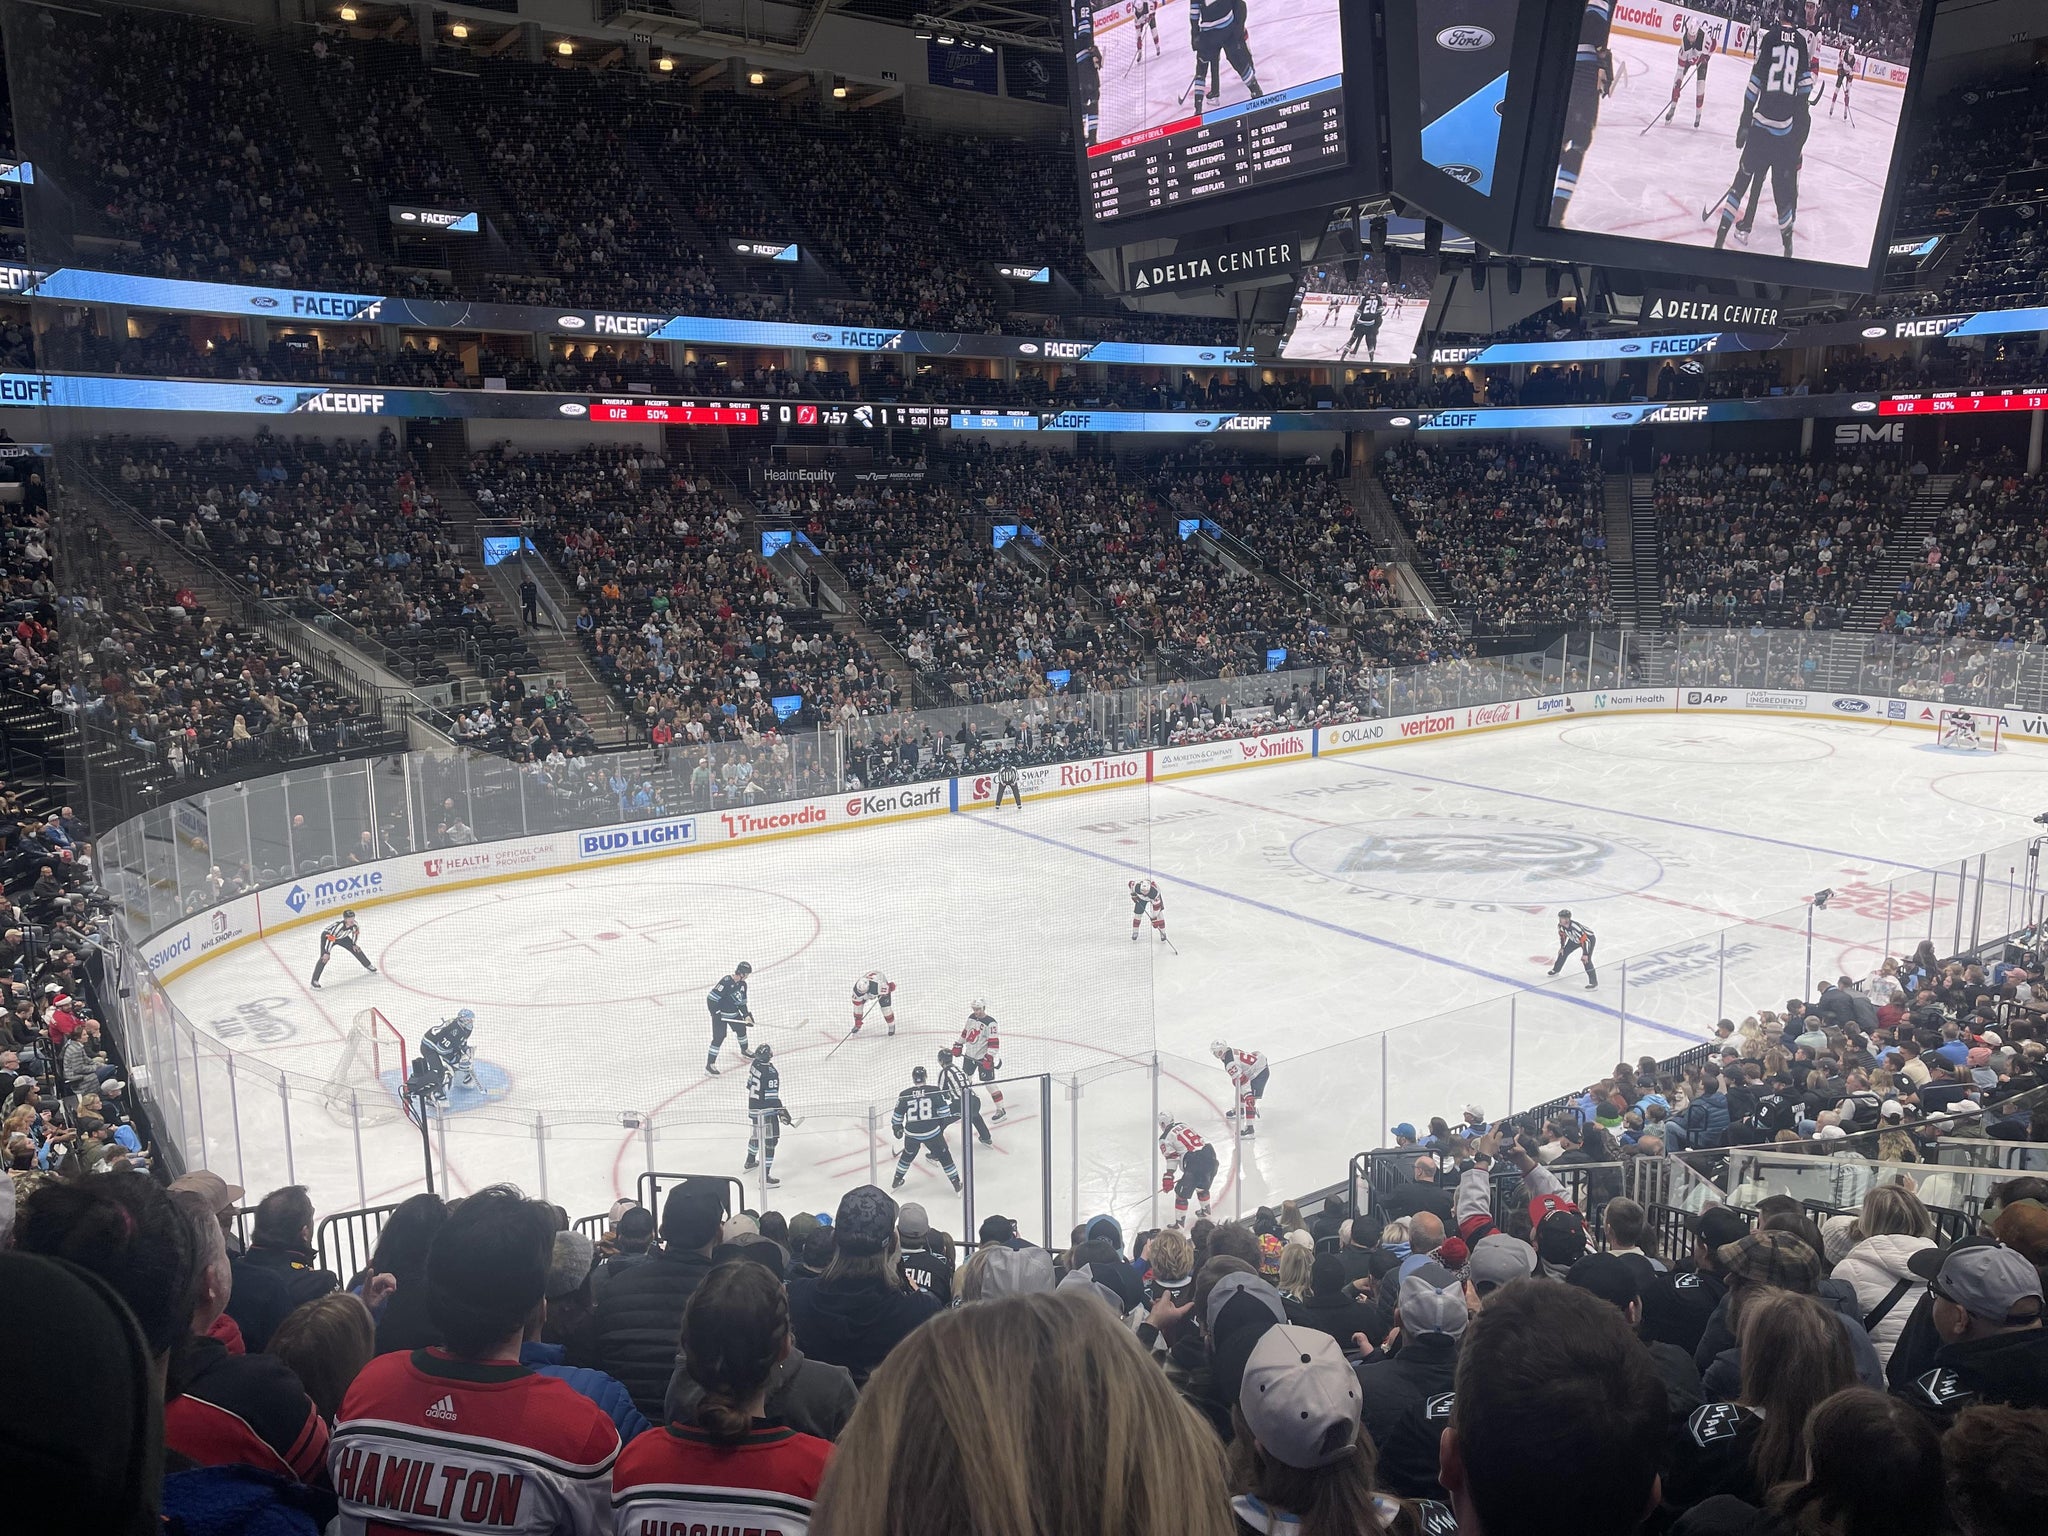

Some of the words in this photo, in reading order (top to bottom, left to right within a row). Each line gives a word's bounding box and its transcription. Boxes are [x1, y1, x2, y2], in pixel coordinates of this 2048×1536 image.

[1080, 7, 1090, 18] 82
[1781, 30, 1795, 43] COLE
[1767, 45, 1800, 95] 28
[1246, 101, 1260, 110] UTAH
[1260, 93, 1287, 106] MAMMOTH
[1279, 106, 1292, 116] TIME
[1301, 101, 1310, 110] ICE
[1261, 121, 1287, 134] STENLUND
[1323, 108, 1337, 118] 3:14
[1148, 129, 1164, 139] DEVILS
[1198, 129, 1210, 139] HITS
[1262, 136, 1275, 146] COLE
[1324, 120, 1337, 130] 2:25
[1324, 132, 1338, 142] 5:26
[1186, 144, 1208, 156] BLOCKED
[1208, 139, 1224, 152] SHOTS
[1322, 144, 1339, 155] 11:41
[1111, 154, 1122, 162] TIME
[1187, 159, 1200, 169] SHOT
[1200, 153, 1225, 167] ATTEMPTS
[1237, 148, 1245, 156] 11
[1167, 179, 1179, 188] 50%
[1194, 171, 1214, 181] FACEOFF
[1236, 162, 1249, 171] 50%
[1149, 188, 1160, 196] 2:52
[1169, 192, 1179, 200] 0/2
[1192, 183, 1210, 196] POWER
[1210, 181, 1225, 192] PLAYS
[1238, 175, 1248, 184] 1/1
[1153, 259, 1211, 285] DELTA
[1218, 244, 1291, 273] CENTER
[292, 296, 381, 320] FACEOFF
[1363, 299, 1378, 314] 28
[1667, 302, 1718, 322] DELTA
[1723, 304, 1778, 326] CENTER
[594, 314, 666, 335] FACEOFF
[1895, 318, 1965, 338] FACEOFF
[841, 331, 901, 350] FACEOFF
[1651, 337, 1718, 354] FACEOFF
[1044, 342, 1095, 360] FACEOFF
[1897, 403, 1914, 412] 0/2
[1933, 401, 1955, 410] 50%
[1974, 401, 1980, 409] 7
[2029, 398, 2041, 407] 13
[609, 408, 627, 419] 0/2
[647, 409, 669, 420] 50%
[686, 411, 692, 420] 7
[736, 412, 747, 422] 13
[762, 412, 769, 421] 5
[780, 406, 791, 422] 0
[822, 411, 848, 424] 7:57
[880, 409, 887, 424] 1
[898, 415, 905, 424] 4
[911, 416, 927, 426] 2:00
[933, 416, 949, 426] 0:57
[963, 416, 968, 426] 5
[981, 417, 998, 427] 50%
[1013, 418, 1024, 427] 1/1
[764, 469, 835, 484] HealthEquity
[1537, 697, 1564, 711] Layton
[1611, 695, 1633, 704] Nomi
[1636, 694, 1665, 704] Health
[1750, 696, 1804, 706] INGREDIENTS
[1837, 700, 1865, 712] Ford
[1400, 715, 1455, 737] verizon
[1342, 725, 1384, 743] OKLAND
[1260, 736, 1304, 758] Smith's
[1173, 753, 1201, 763] MORETON
[1206, 748, 1232, 758] COMPANY
[1021, 769, 1049, 781] SWAPP
[1060, 765, 1092, 787] Rio
[1092, 760, 1138, 781] Tinto
[863, 796, 896, 815] Ken
[899, 786, 941, 809] Garff
[738, 805, 826, 833] Trucordia
[584, 832, 629, 853] BUD
[632, 823, 692, 846] LIGHT
[496, 847, 532, 860] OFFICIAL
[533, 844, 553, 855] CARE
[446, 854, 490, 869] HEALTH
[496, 855, 537, 867] PROVIDER
[314, 871, 383, 898] moxie
[315, 896, 339, 908] PEST
[341, 886, 383, 901] CONTROL
[990, 1026, 997, 1034] 13
[442, 1037, 451, 1047] 70
[1228, 1065, 1239, 1076] 63
[768, 1079, 778, 1088] 82
[912, 1090, 926, 1098] COLE
[907, 1098, 933, 1121] 28
[1760, 1106, 1768, 1117] 9
[1176, 1128, 1204, 1152] 18
[425, 1407, 458, 1421] adidas
[1703, 1405, 1730, 1437] UTAH
[338, 1446, 524, 1526] HAMILTON
